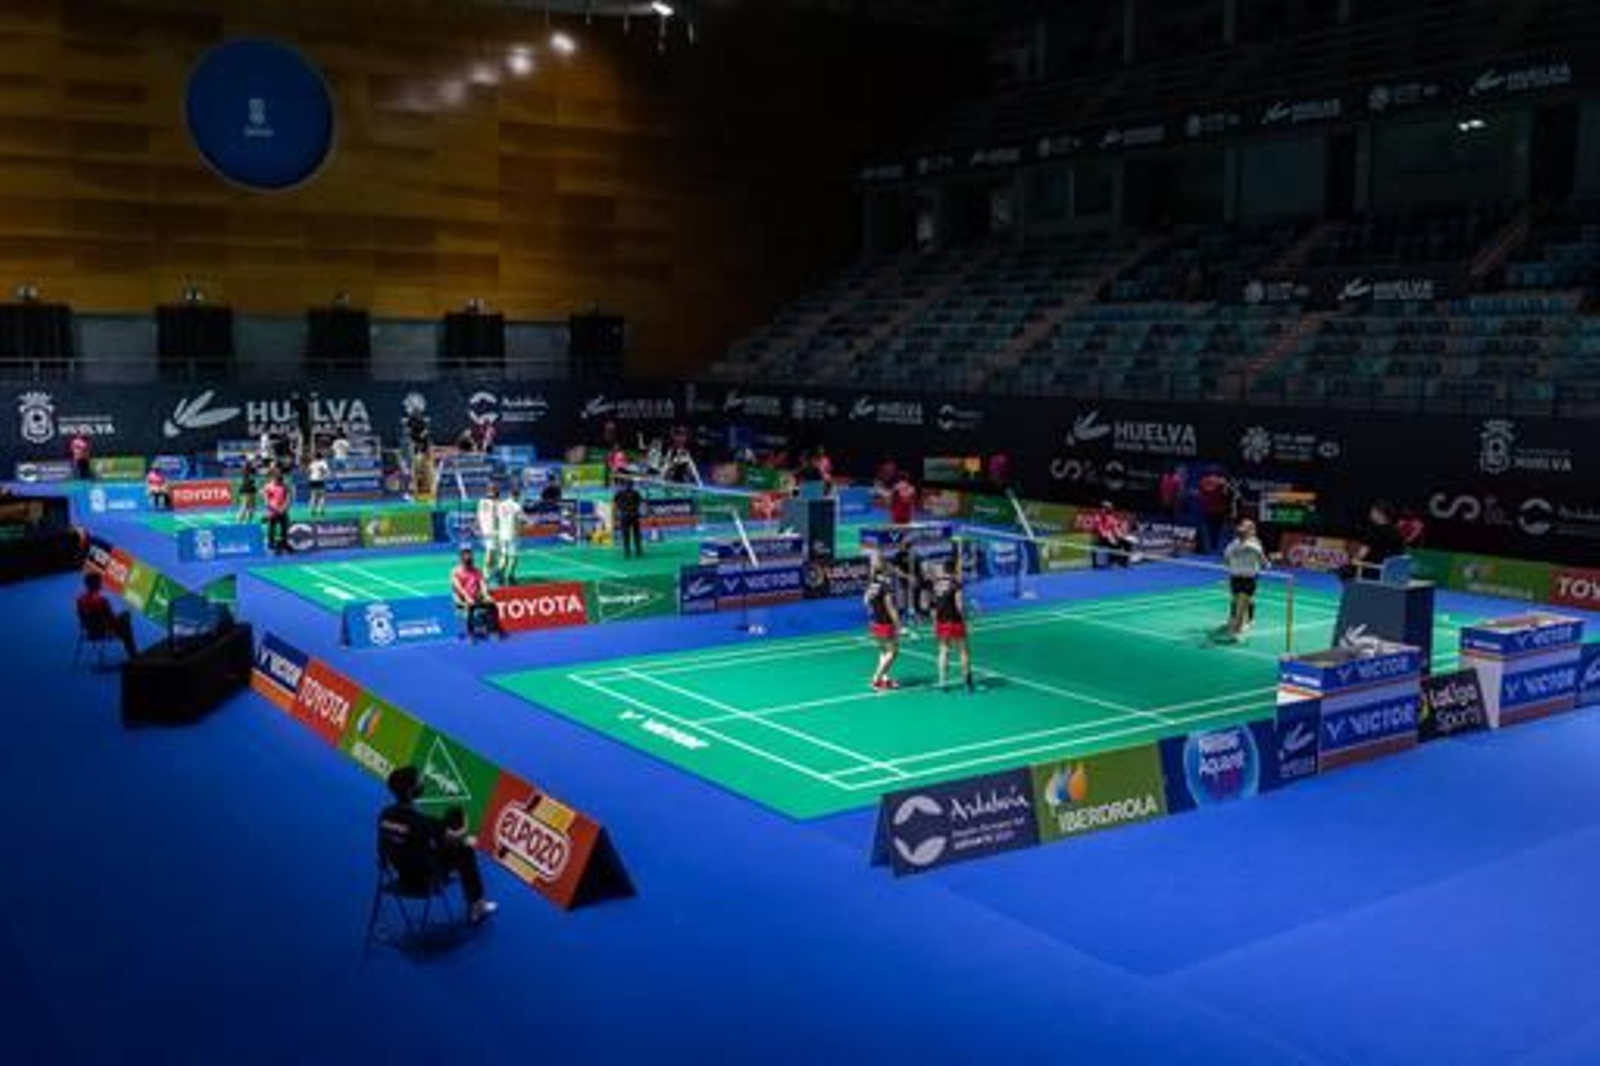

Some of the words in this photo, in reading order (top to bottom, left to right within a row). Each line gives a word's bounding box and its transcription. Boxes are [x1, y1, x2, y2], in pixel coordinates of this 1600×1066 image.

[248, 399, 370, 422] HULVA
[1113, 421, 1197, 444] HUELVA
[496, 594, 584, 619] TOYOTA
[1355, 654, 1410, 679] VICTOR
[1522, 669, 1577, 697] VICTOR
[299, 676, 350, 730] TOYOTA
[1350, 698, 1416, 735] VICTOR
[1057, 794, 1160, 833] IBERDROLA
